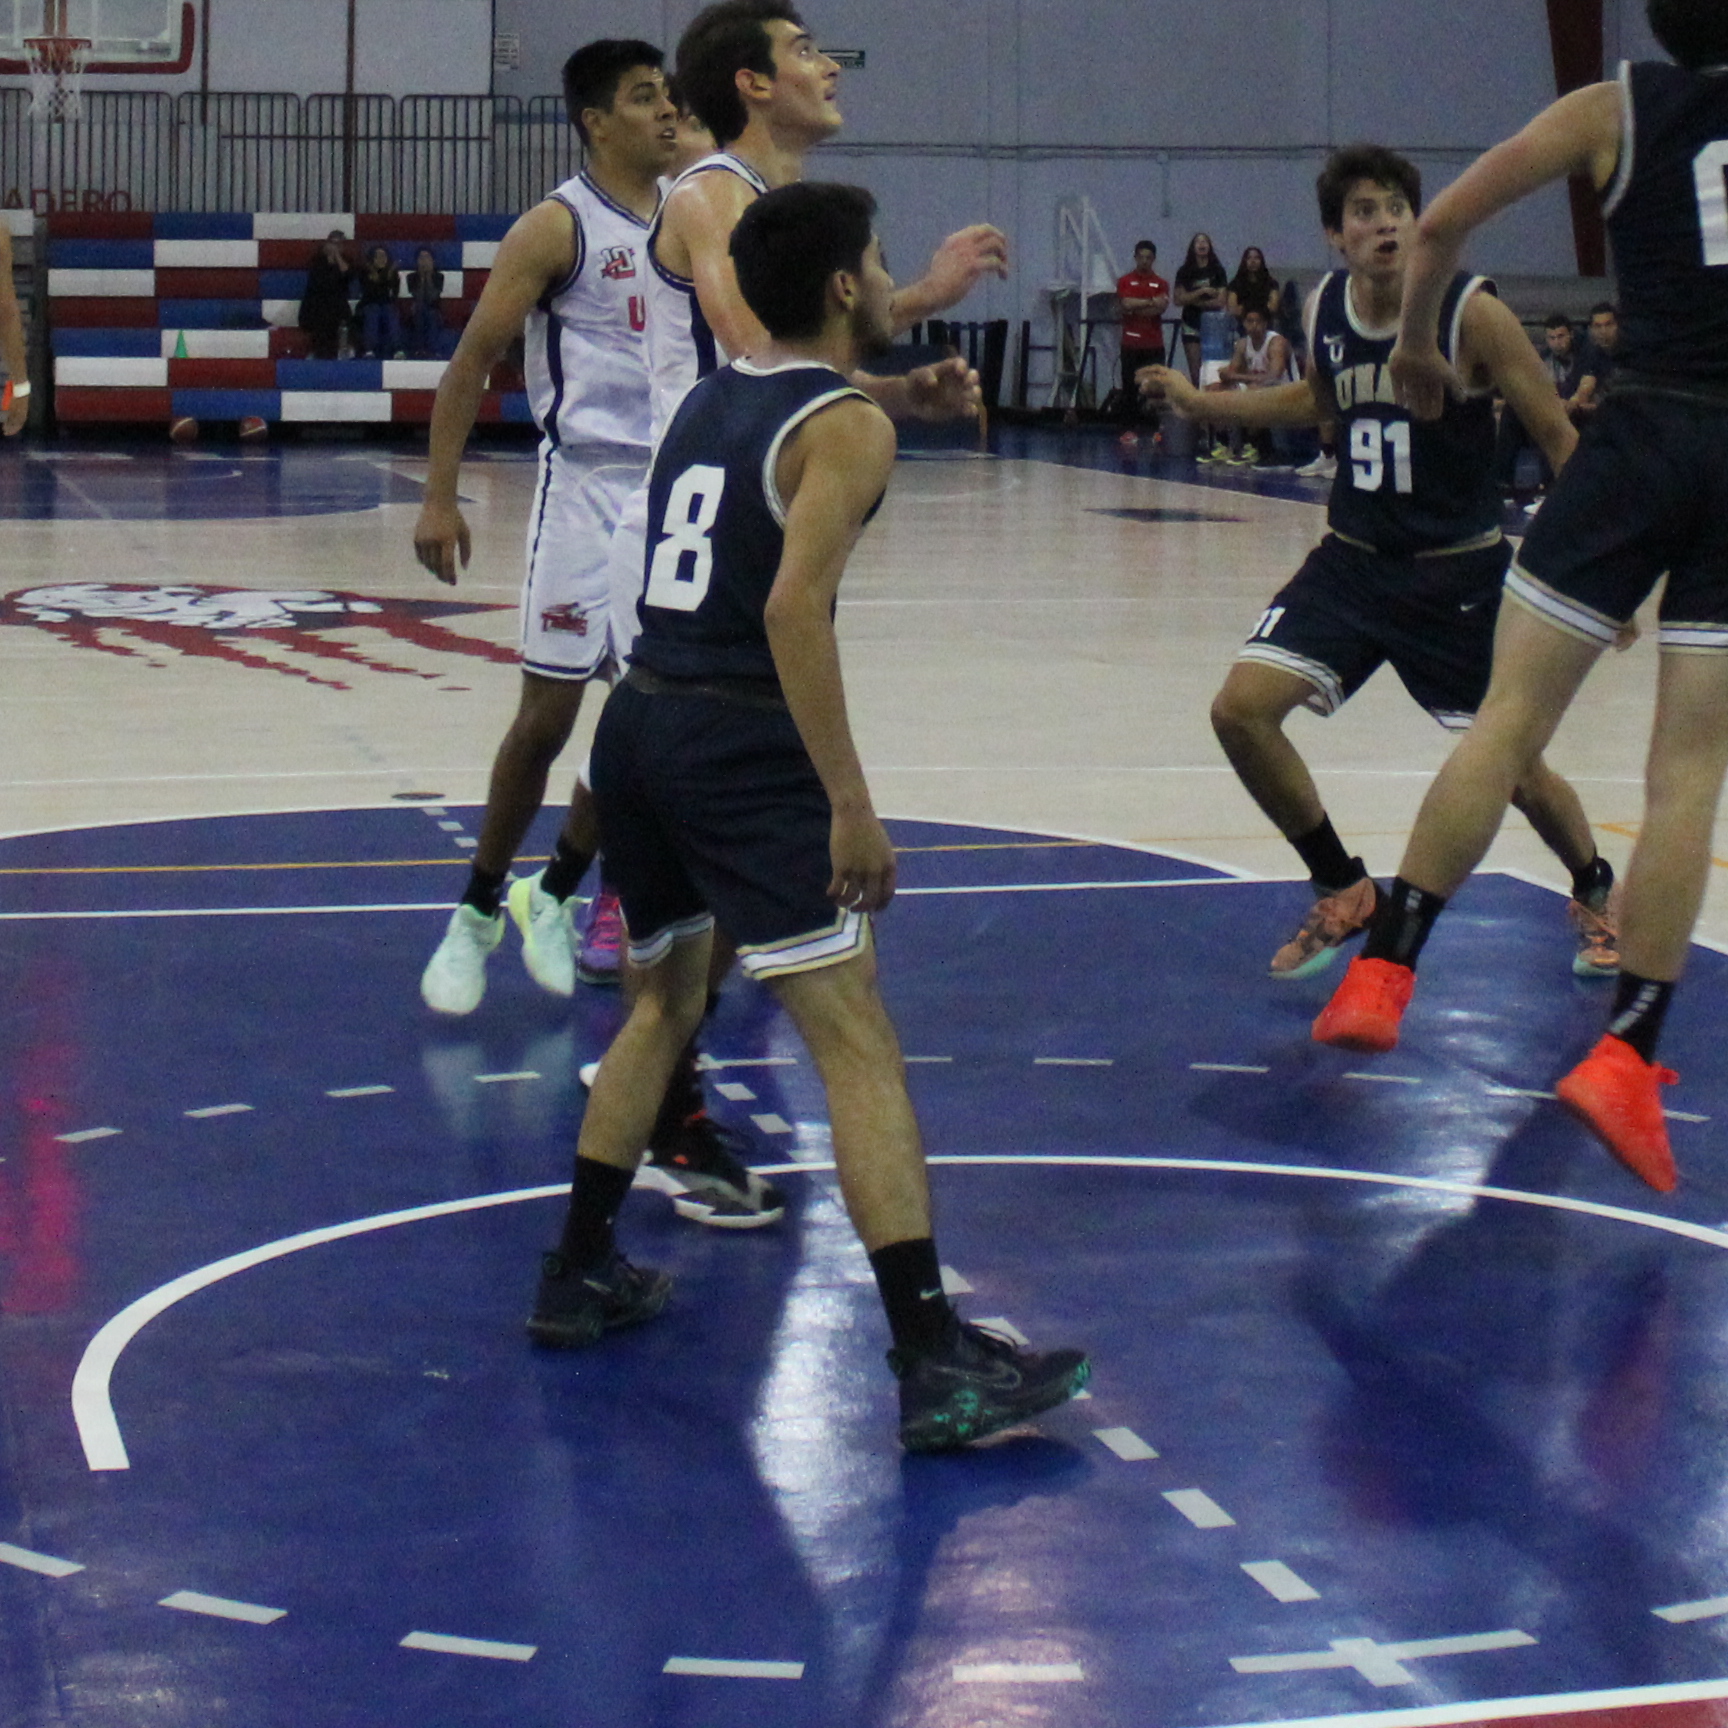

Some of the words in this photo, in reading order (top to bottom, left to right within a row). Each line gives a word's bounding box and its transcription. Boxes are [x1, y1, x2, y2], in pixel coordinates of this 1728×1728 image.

[1334, 362, 1396, 411] UNA
[1350, 418, 1413, 494] 91
[645, 463, 726, 612] 8
